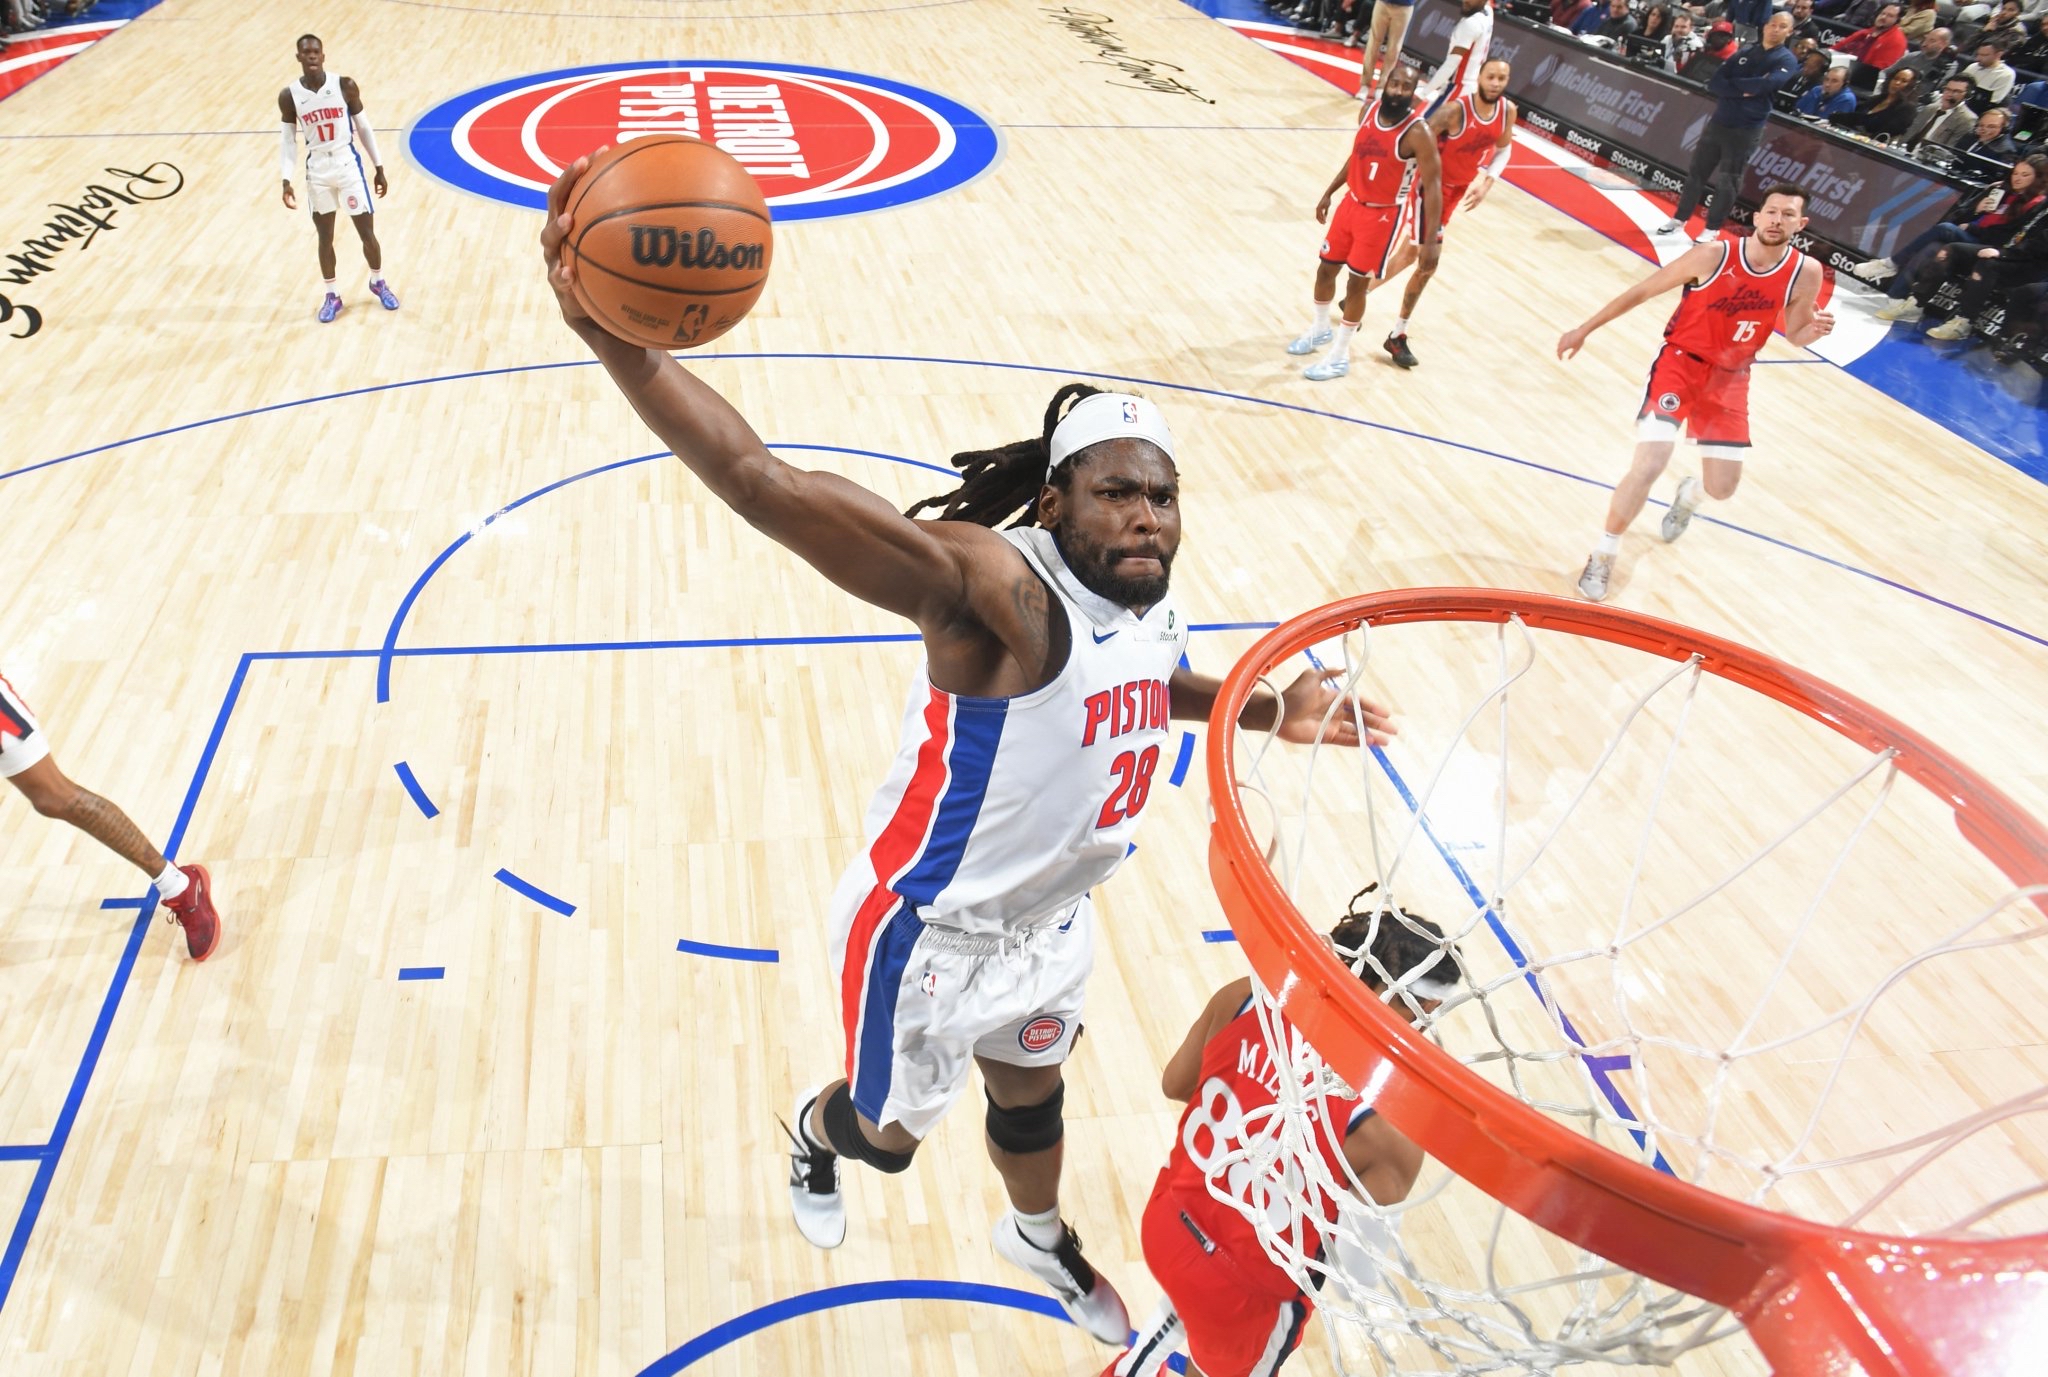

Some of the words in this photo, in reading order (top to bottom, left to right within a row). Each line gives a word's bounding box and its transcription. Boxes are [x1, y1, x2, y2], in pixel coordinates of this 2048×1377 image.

[616, 83, 701, 144] PIST
[1551, 62, 1623, 107] Michigan
[1618, 88, 1666, 124] First
[1587, 103, 1621, 126] CREDIT
[302, 107, 344, 126] PISTONS
[317, 123, 335, 142] 17
[707, 84, 810, 179] DETROIT
[1368, 161, 1379, 181] 1
[1527, 111, 1559, 133] StockX
[1566, 130, 1602, 153] StockX
[1610, 151, 1649, 175] StockX
[1652, 170, 1684, 193] Stock
[1748, 143, 1806, 182] igan
[1800, 162, 1866, 205] First
[1808, 194, 1844, 221] NION
[628, 224, 765, 270] Wilson
[1708, 296, 1775, 318] Angeles
[1731, 284, 1762, 300] Los
[1732, 320, 1762, 342] 15
[1081, 679, 1170, 748] PISTON
[1095, 743, 1160, 829] 28
[1182, 1076, 1306, 1234] 88
